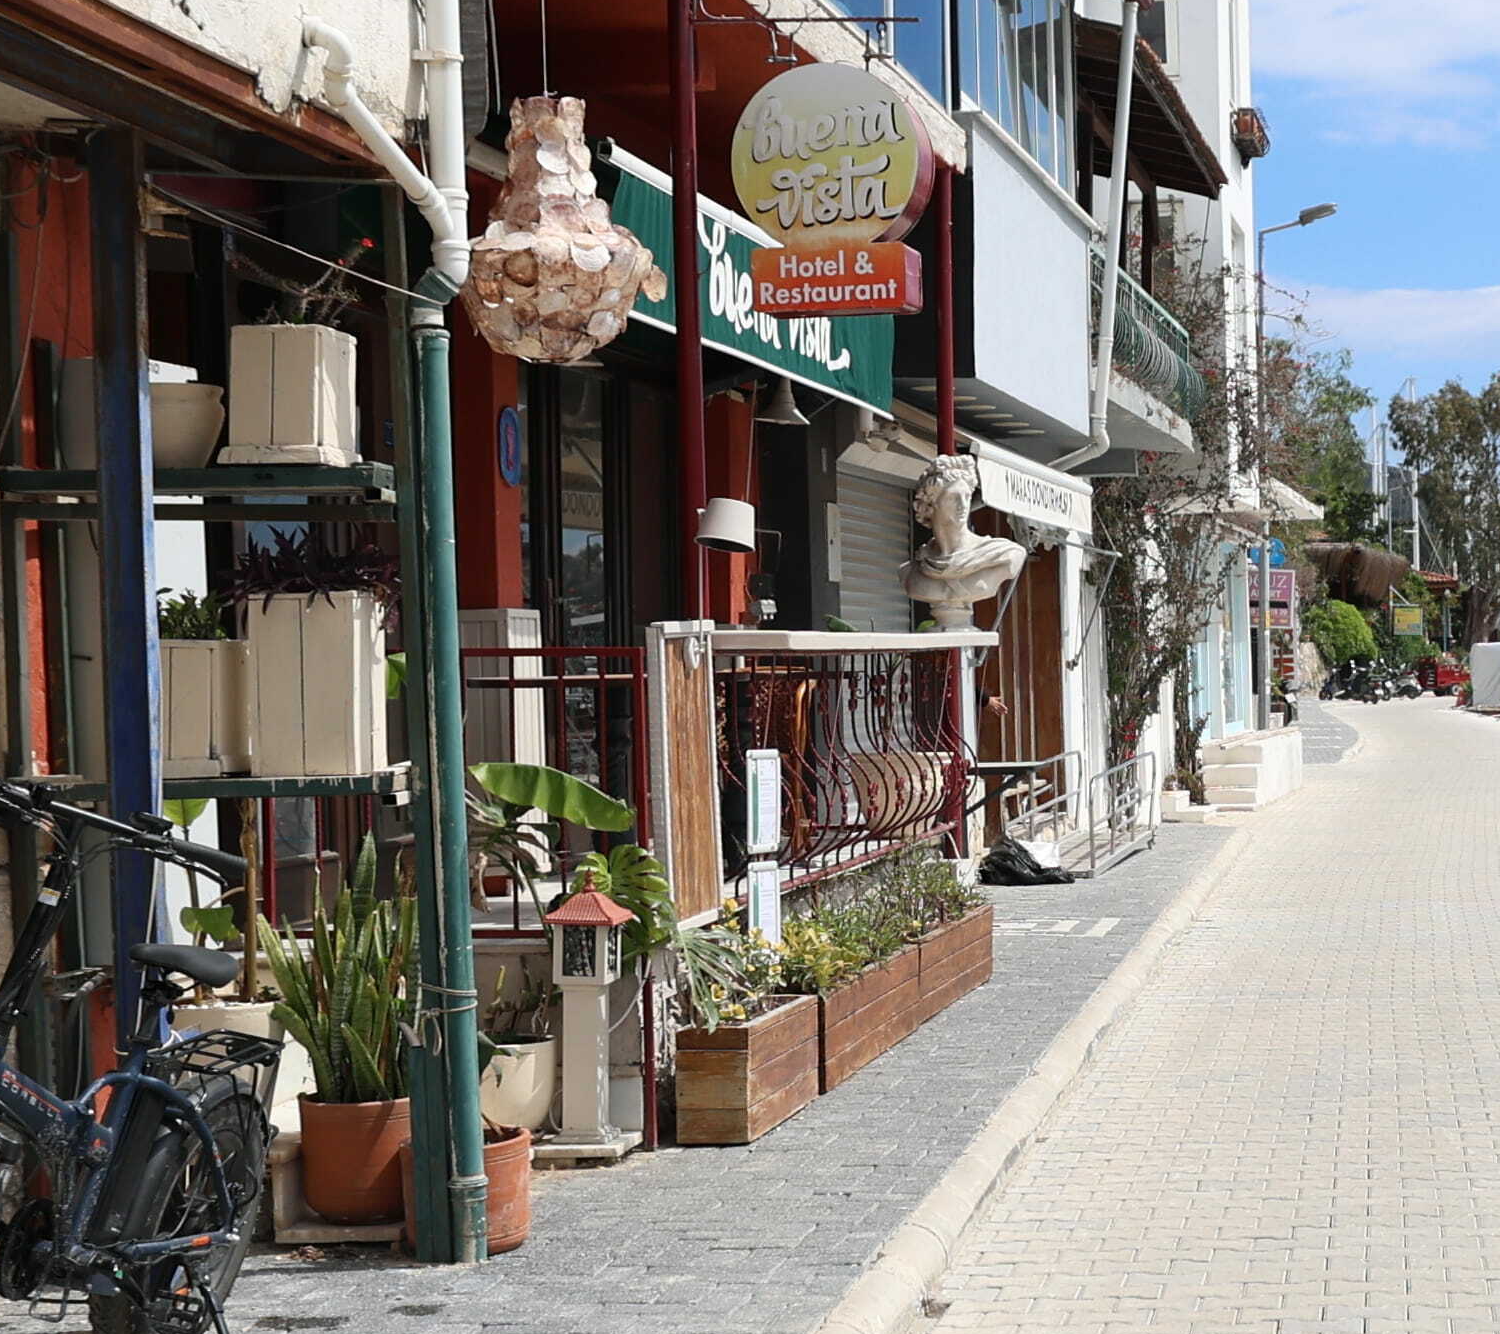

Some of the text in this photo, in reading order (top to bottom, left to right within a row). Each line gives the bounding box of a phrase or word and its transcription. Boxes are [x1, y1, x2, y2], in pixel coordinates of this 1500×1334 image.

[743, 96, 905, 163] buena
[779, 249, 875, 279] Hotel &
[759, 278, 898, 306] Restaurant
